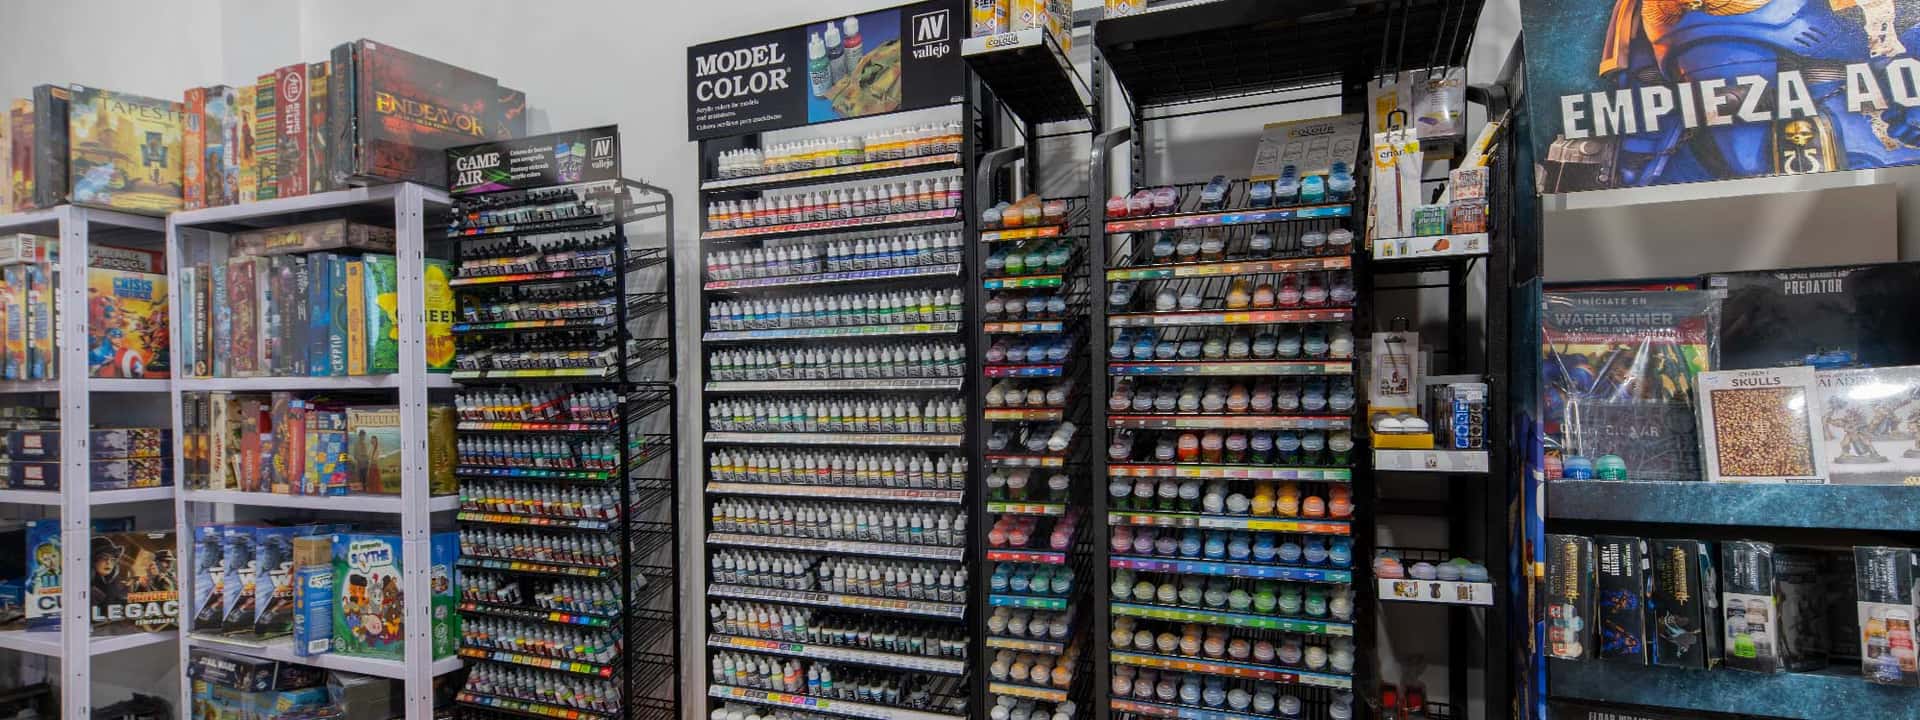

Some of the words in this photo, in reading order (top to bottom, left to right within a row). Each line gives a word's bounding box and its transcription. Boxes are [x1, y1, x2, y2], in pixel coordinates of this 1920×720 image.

[918, 14, 945, 41] AV
[913, 43, 950, 59] vallejo
[696, 43, 785, 77] MODEL
[697, 69, 789, 101] COLOR
[1561, 70, 1817, 139] EMPIEZA
[375, 91, 485, 137] ENDEAVOR
[594, 140, 610, 157] AV
[456, 153, 500, 171] GAME
[591, 160, 614, 170] vallejo
[456, 169, 483, 186] AIR
[1784, 279, 1843, 296] PREDATOR
[1555, 313, 1673, 326] WARHAMMER
[1731, 376, 1781, 387] SKULLS
[92, 600, 178, 622] LEGAC
